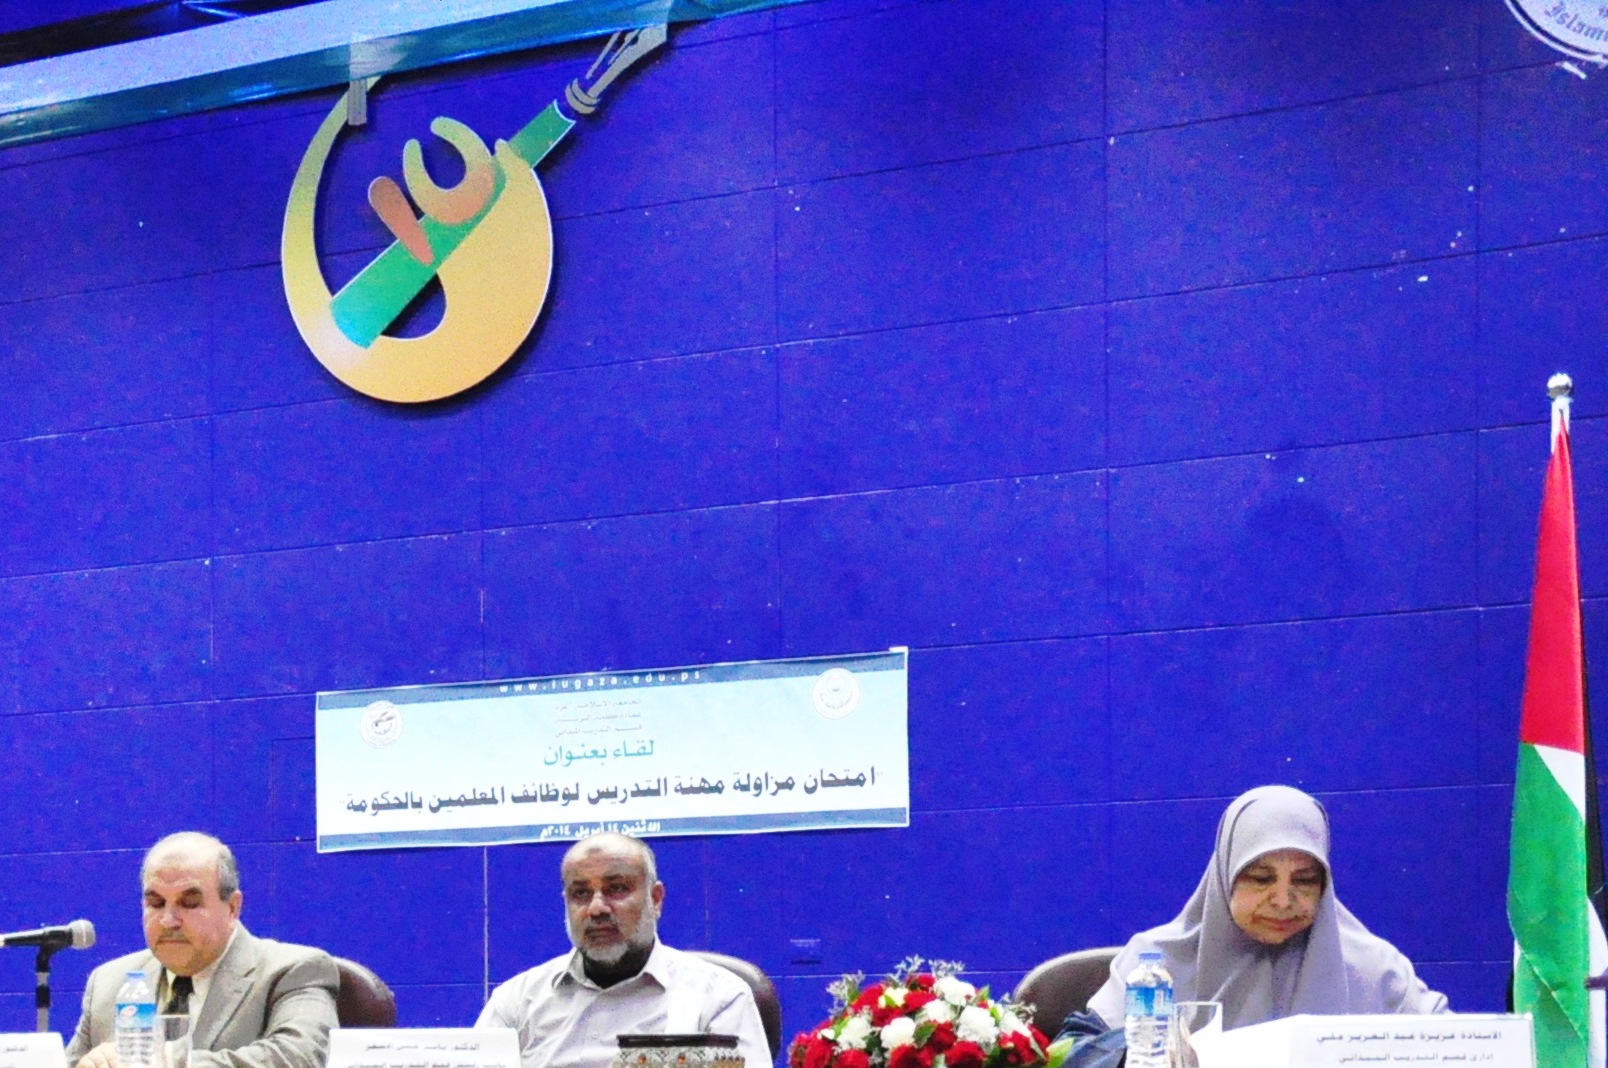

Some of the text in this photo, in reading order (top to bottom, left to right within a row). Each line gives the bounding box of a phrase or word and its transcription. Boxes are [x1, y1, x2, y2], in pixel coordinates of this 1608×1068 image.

[543, 738, 655, 768] لقاء بعنوان
[510, 781, 580, 807] لوظائف
[587, 776, 668, 805] التدريس
[673, 773, 726, 796] مهنة
[732, 770, 796, 798] مزاولة
[428, 784, 506, 814] المعلمين
